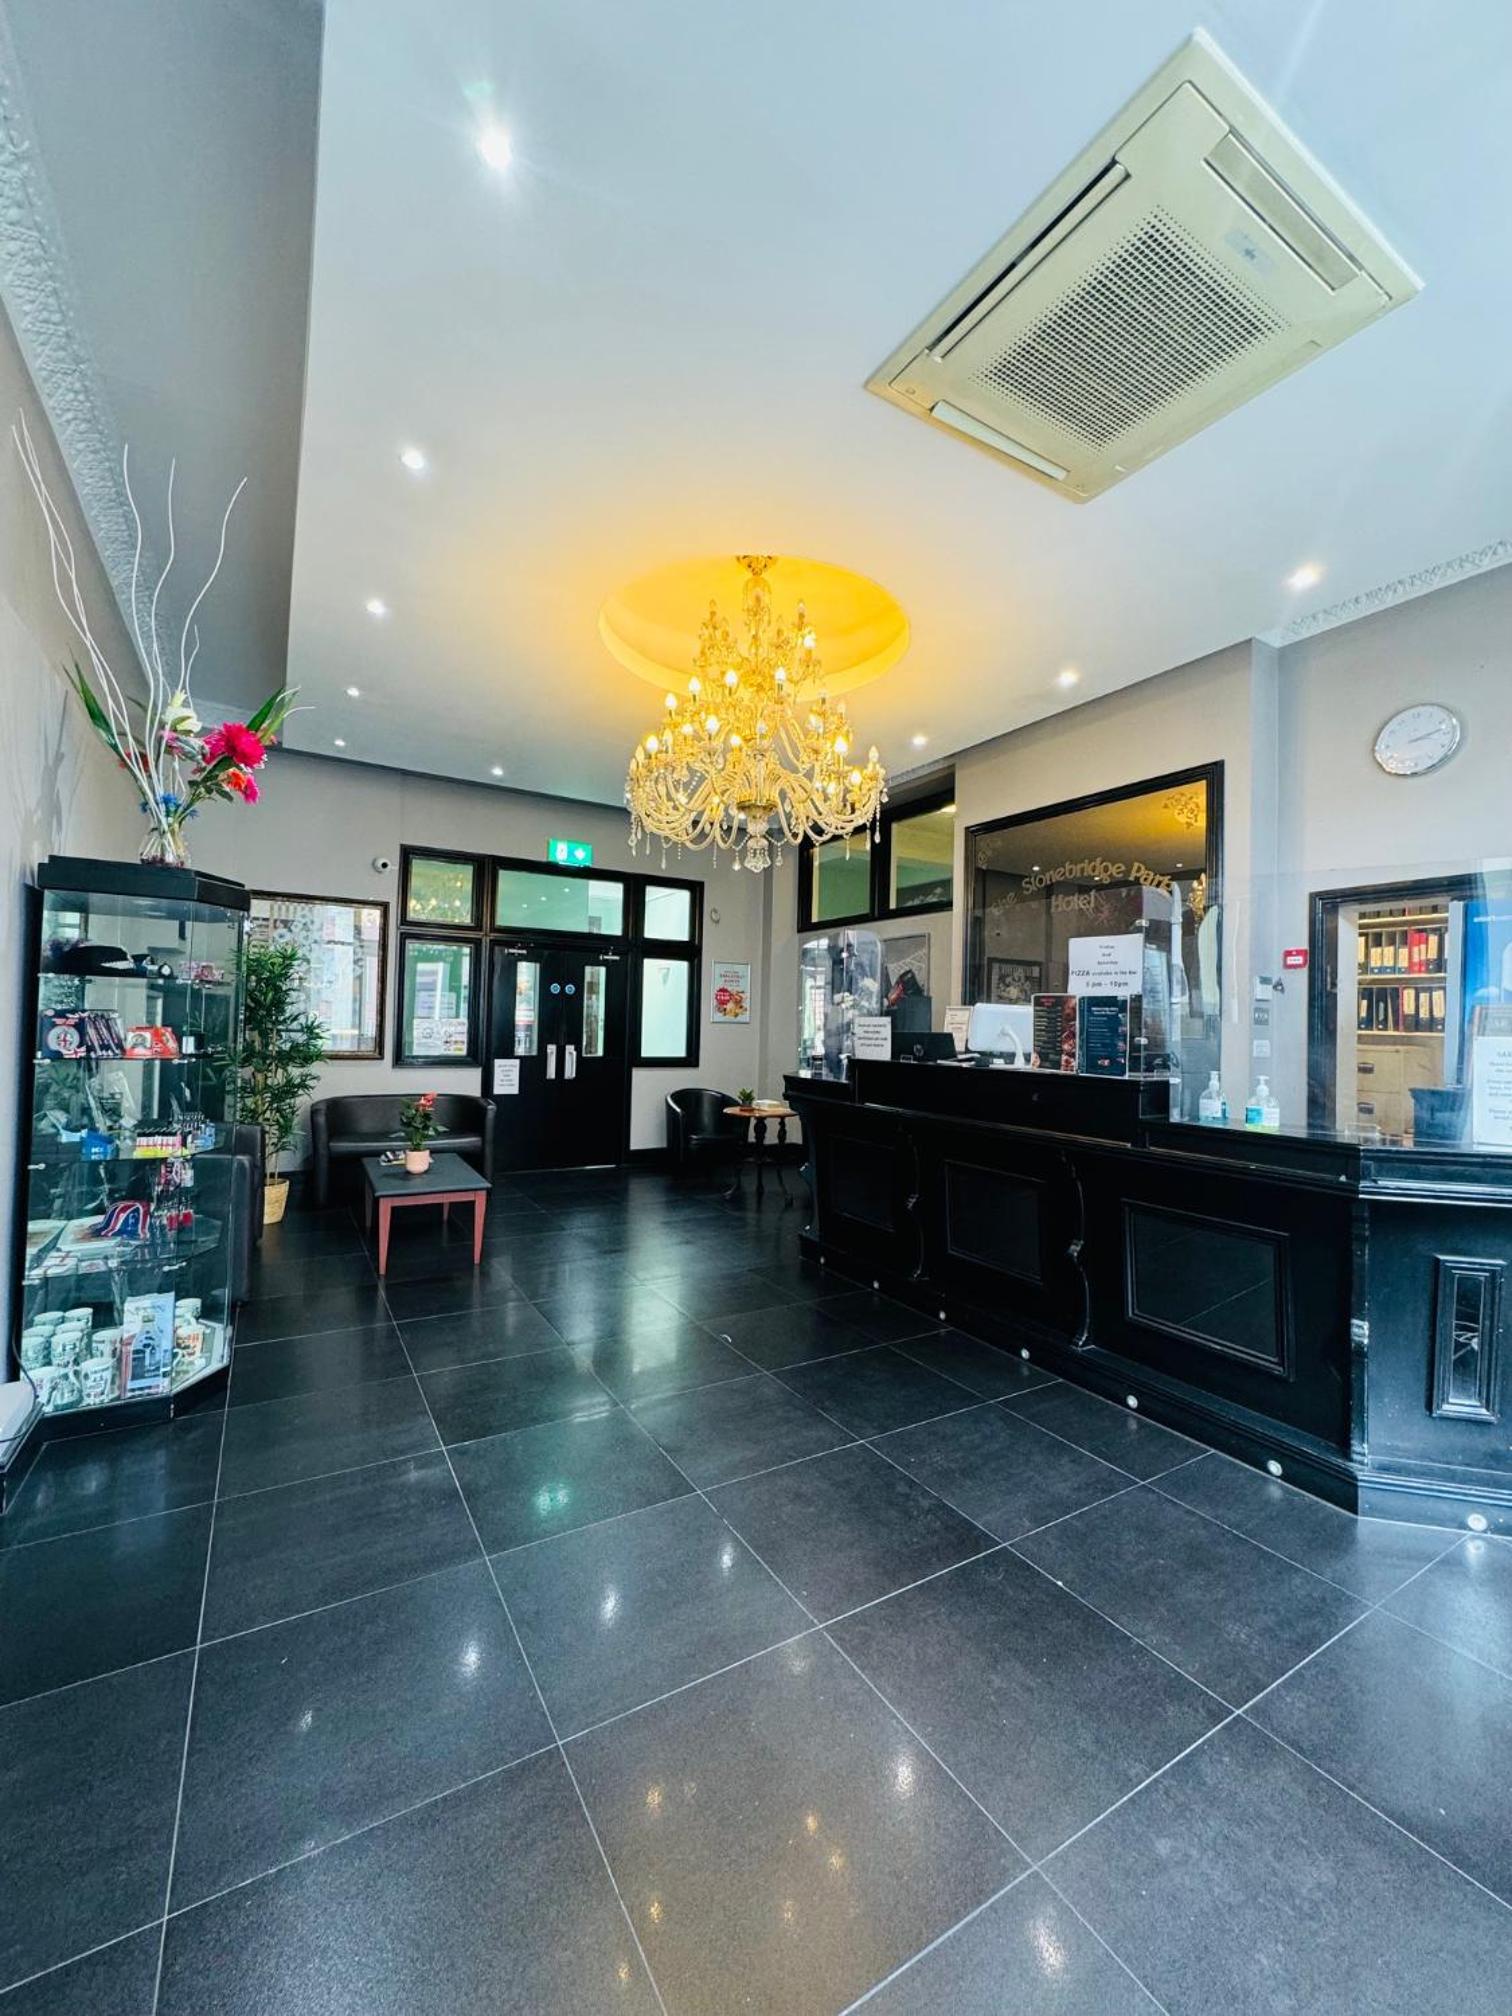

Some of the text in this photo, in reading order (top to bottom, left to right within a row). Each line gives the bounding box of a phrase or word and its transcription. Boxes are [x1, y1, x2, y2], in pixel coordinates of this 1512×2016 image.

[1021, 857, 1127, 895] Stonebridge
[1050, 888, 1096, 913] Hotel
[1071, 969, 1091, 977] PIZZA
